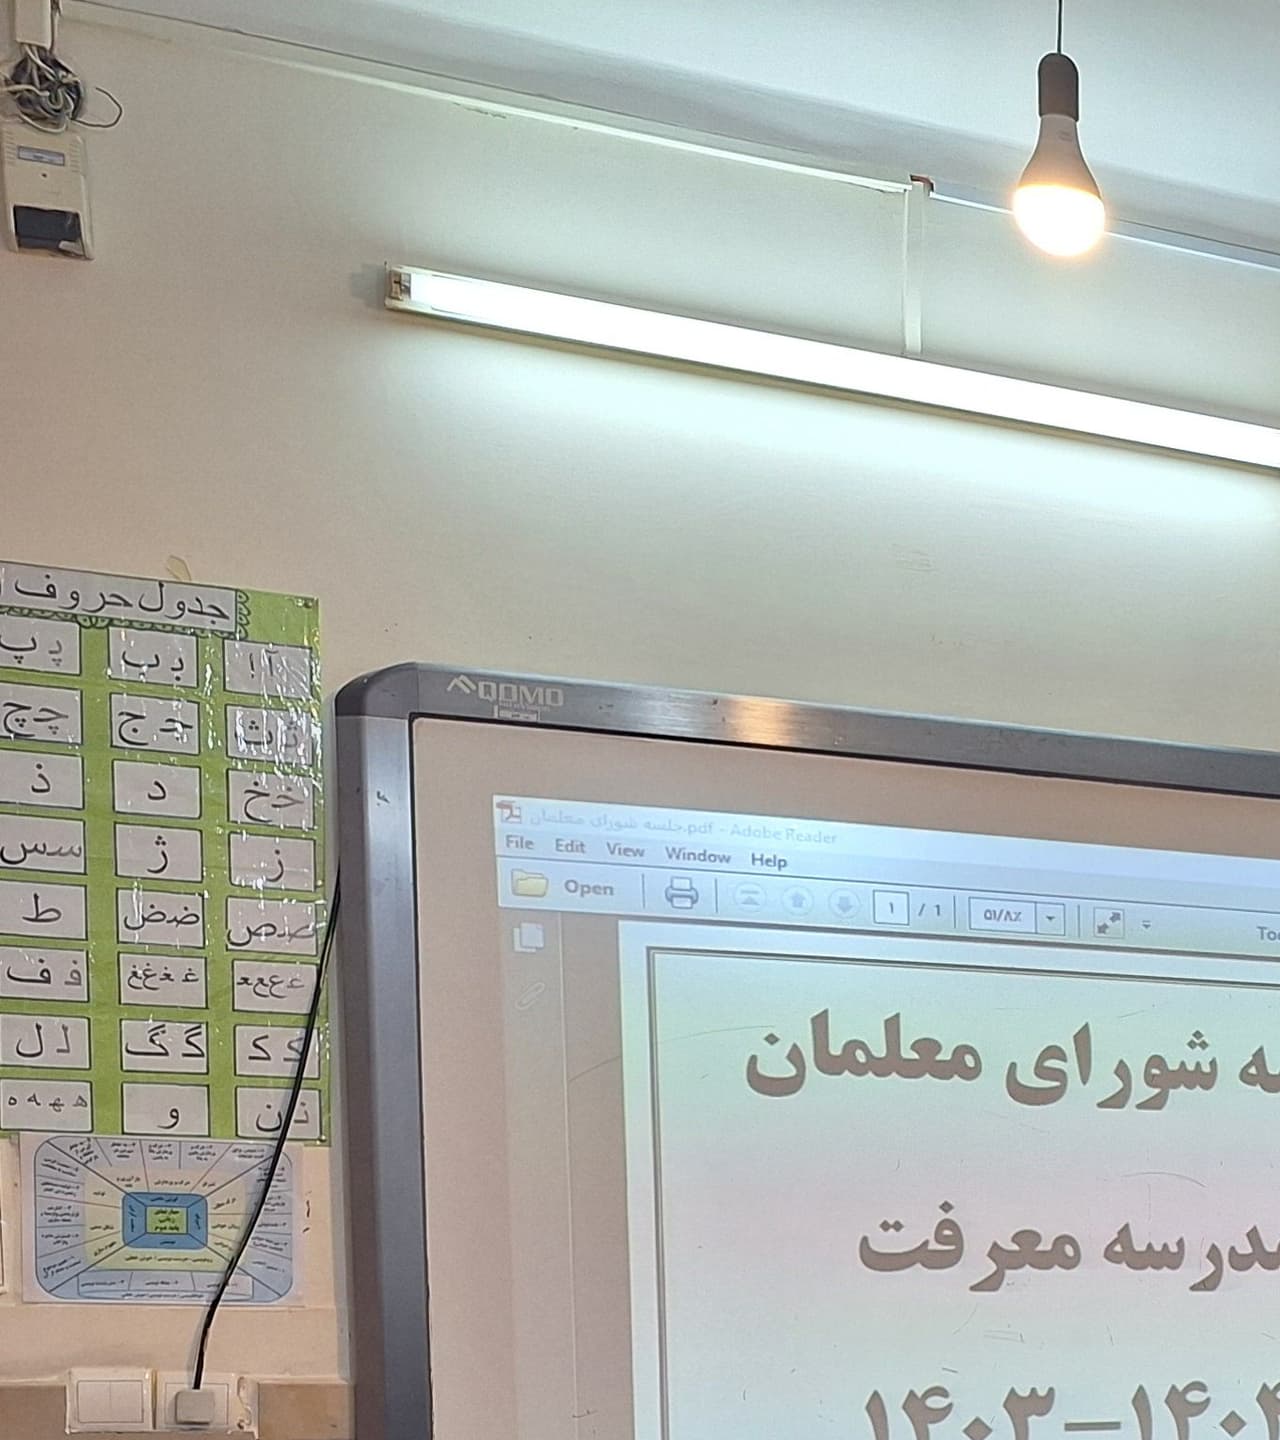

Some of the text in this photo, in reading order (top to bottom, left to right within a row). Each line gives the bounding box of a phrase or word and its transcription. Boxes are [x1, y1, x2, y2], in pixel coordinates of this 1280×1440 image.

[13, 579, 231, 627] جدول حروف
[477, 680, 564, 707] QOMO
[30, 762, 168, 802] د ذ
[505, 833, 789, 871] File Edit View Window Help
[729, 822, 784, 843] Adobe
[785, 828, 838, 846] Reader
[145, 835, 169, 874] ژ
[564, 879, 615, 898] Open
[22, 894, 63, 925] ط
[743, 1006, 987, 1104] معلمان
[1003, 1018, 1220, 1114] شورای
[857, 1198, 1085, 1295] معرفت
